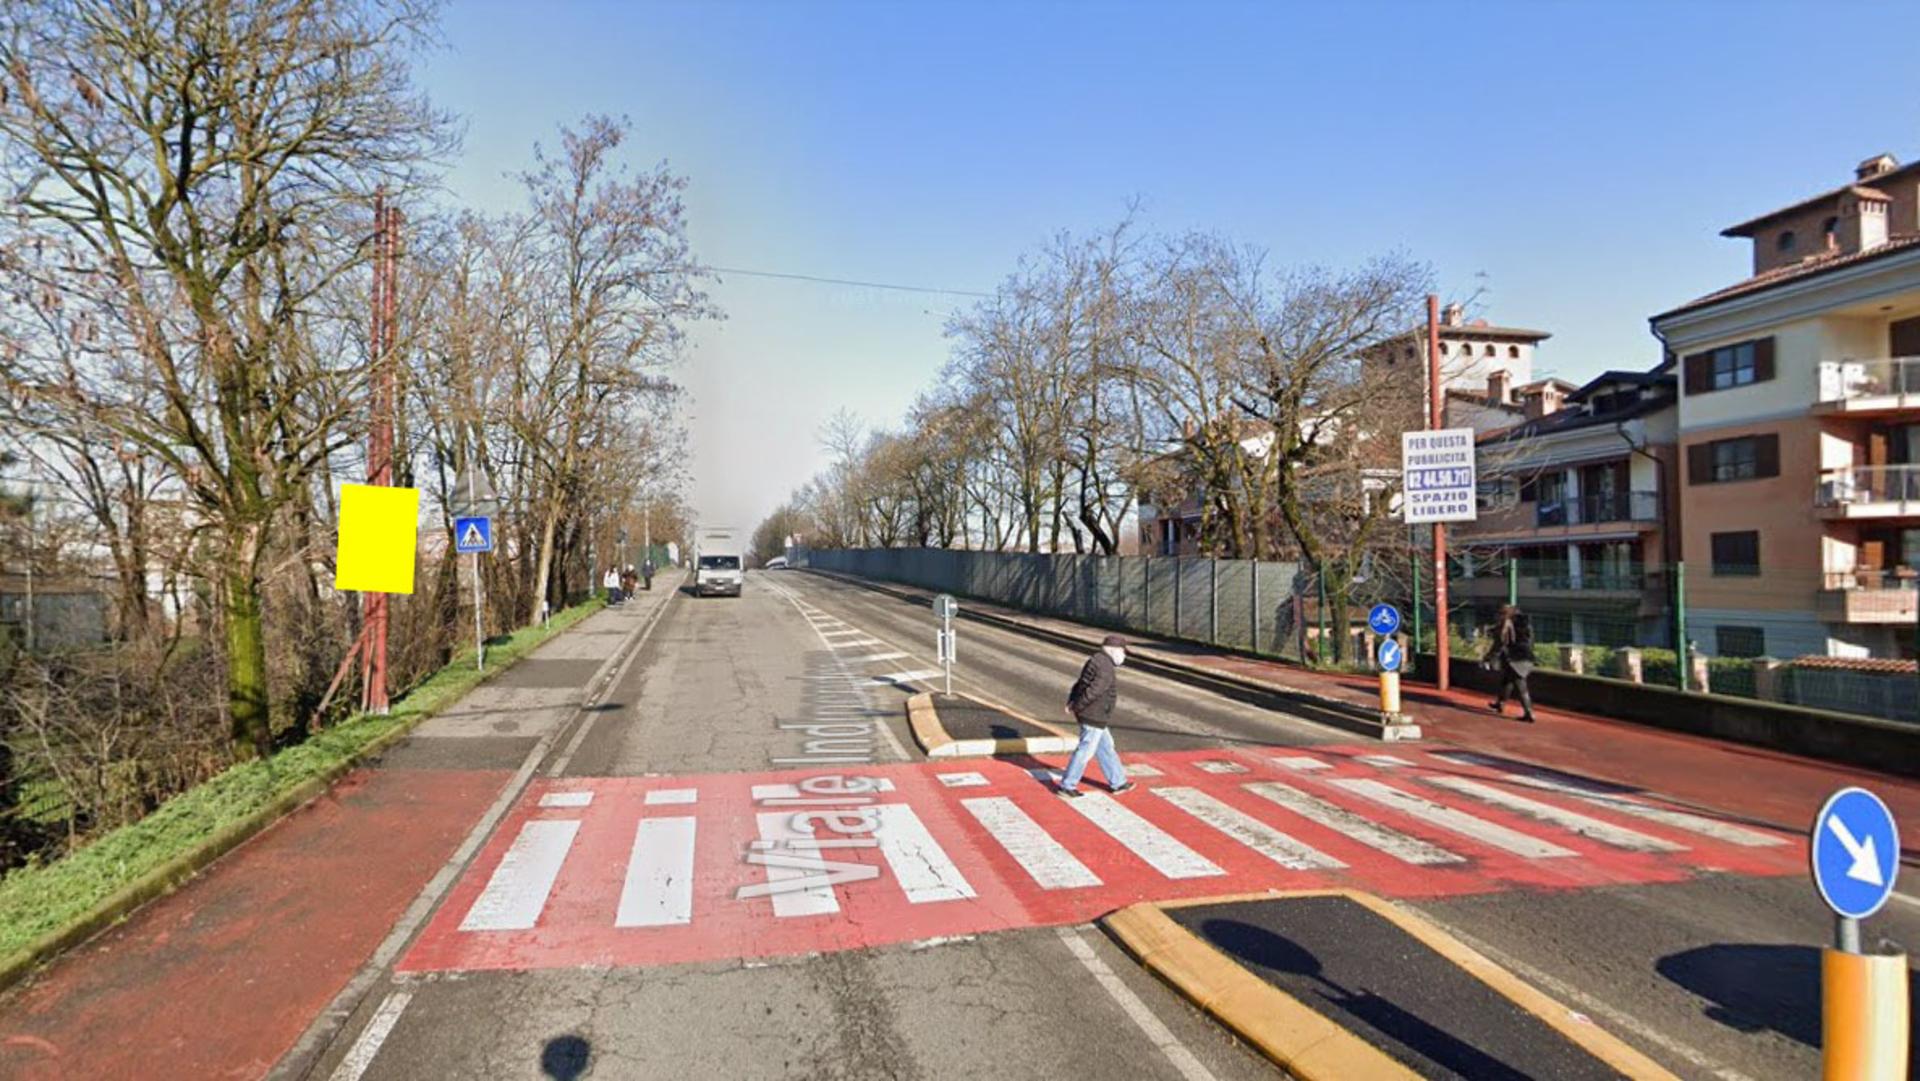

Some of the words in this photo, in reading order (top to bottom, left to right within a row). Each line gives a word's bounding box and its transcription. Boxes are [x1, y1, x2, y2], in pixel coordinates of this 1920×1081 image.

[1408, 438, 1427, 449] PER
[1430, 435, 1466, 448] QUESTA
[1411, 492, 1468, 503] SPAZIO
[1412, 504, 1468, 516] LIBERO
